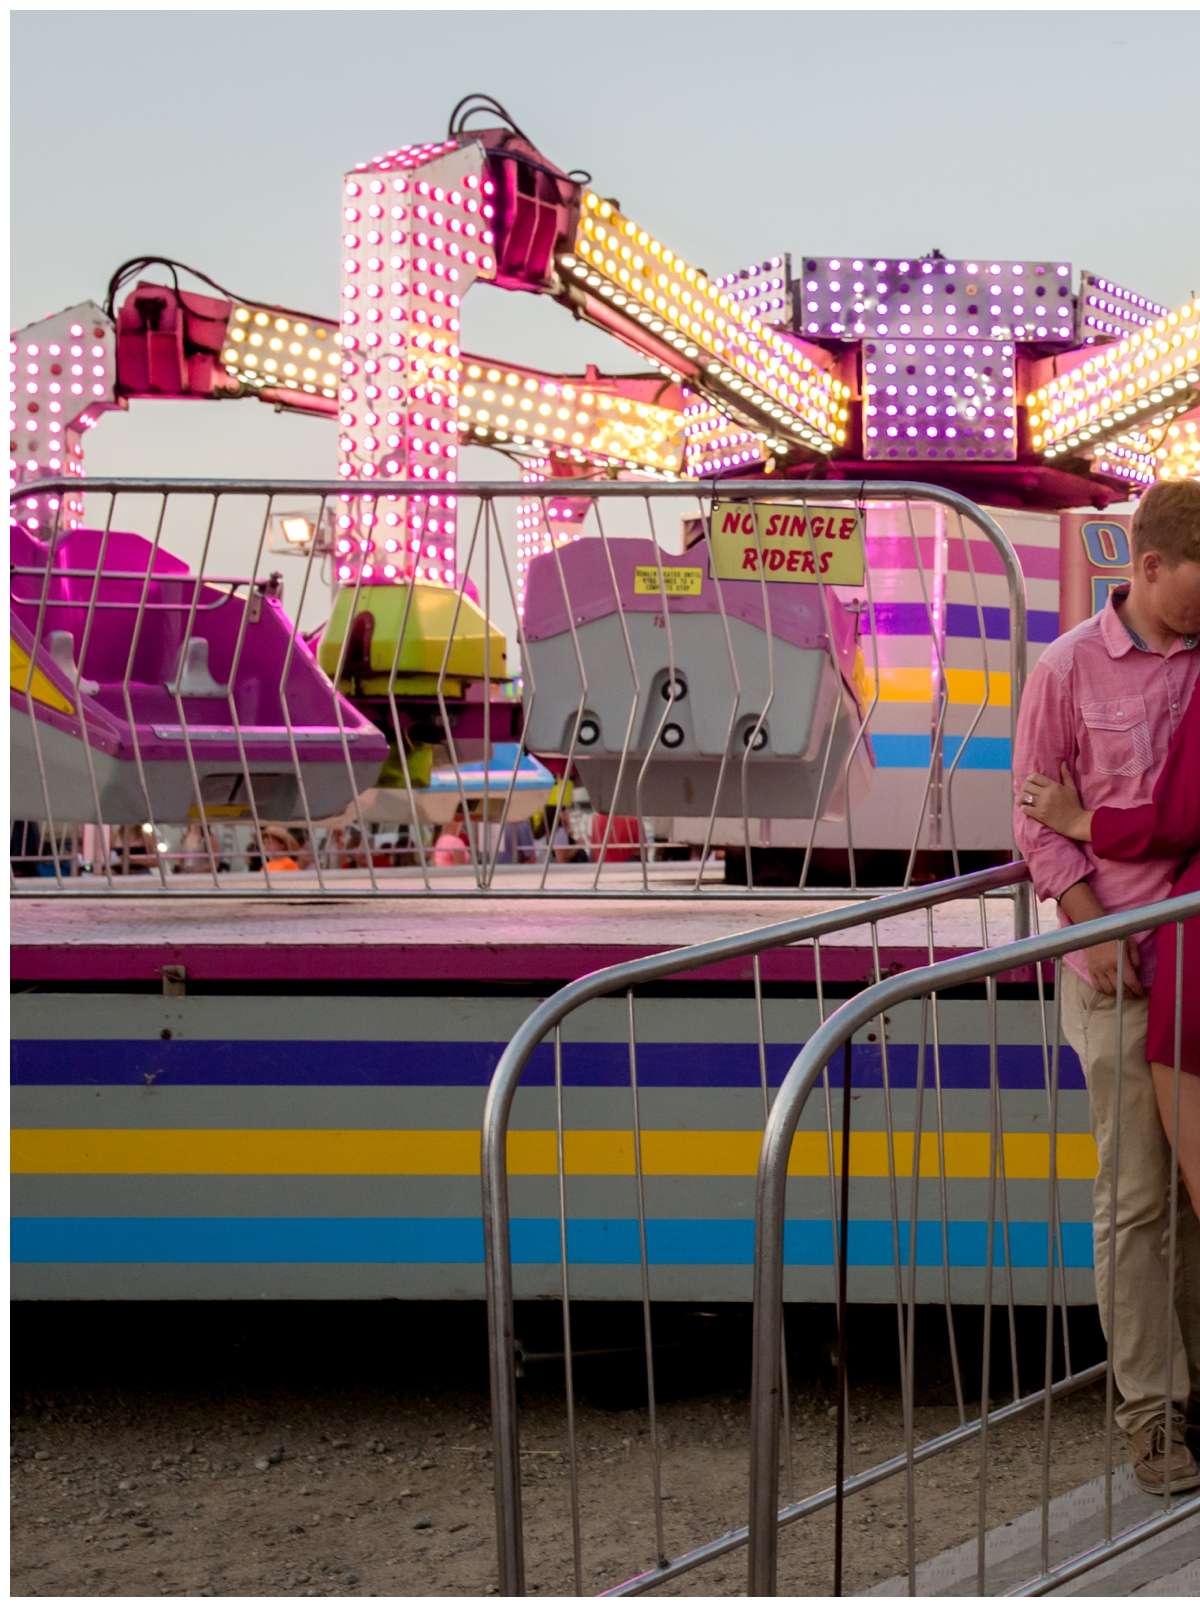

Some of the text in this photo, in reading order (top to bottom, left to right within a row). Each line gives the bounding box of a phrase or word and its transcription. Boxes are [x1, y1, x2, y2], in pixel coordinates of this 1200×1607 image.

[721, 512, 856, 540] NO SINGLE
[742, 547, 833, 574] RIDERS
